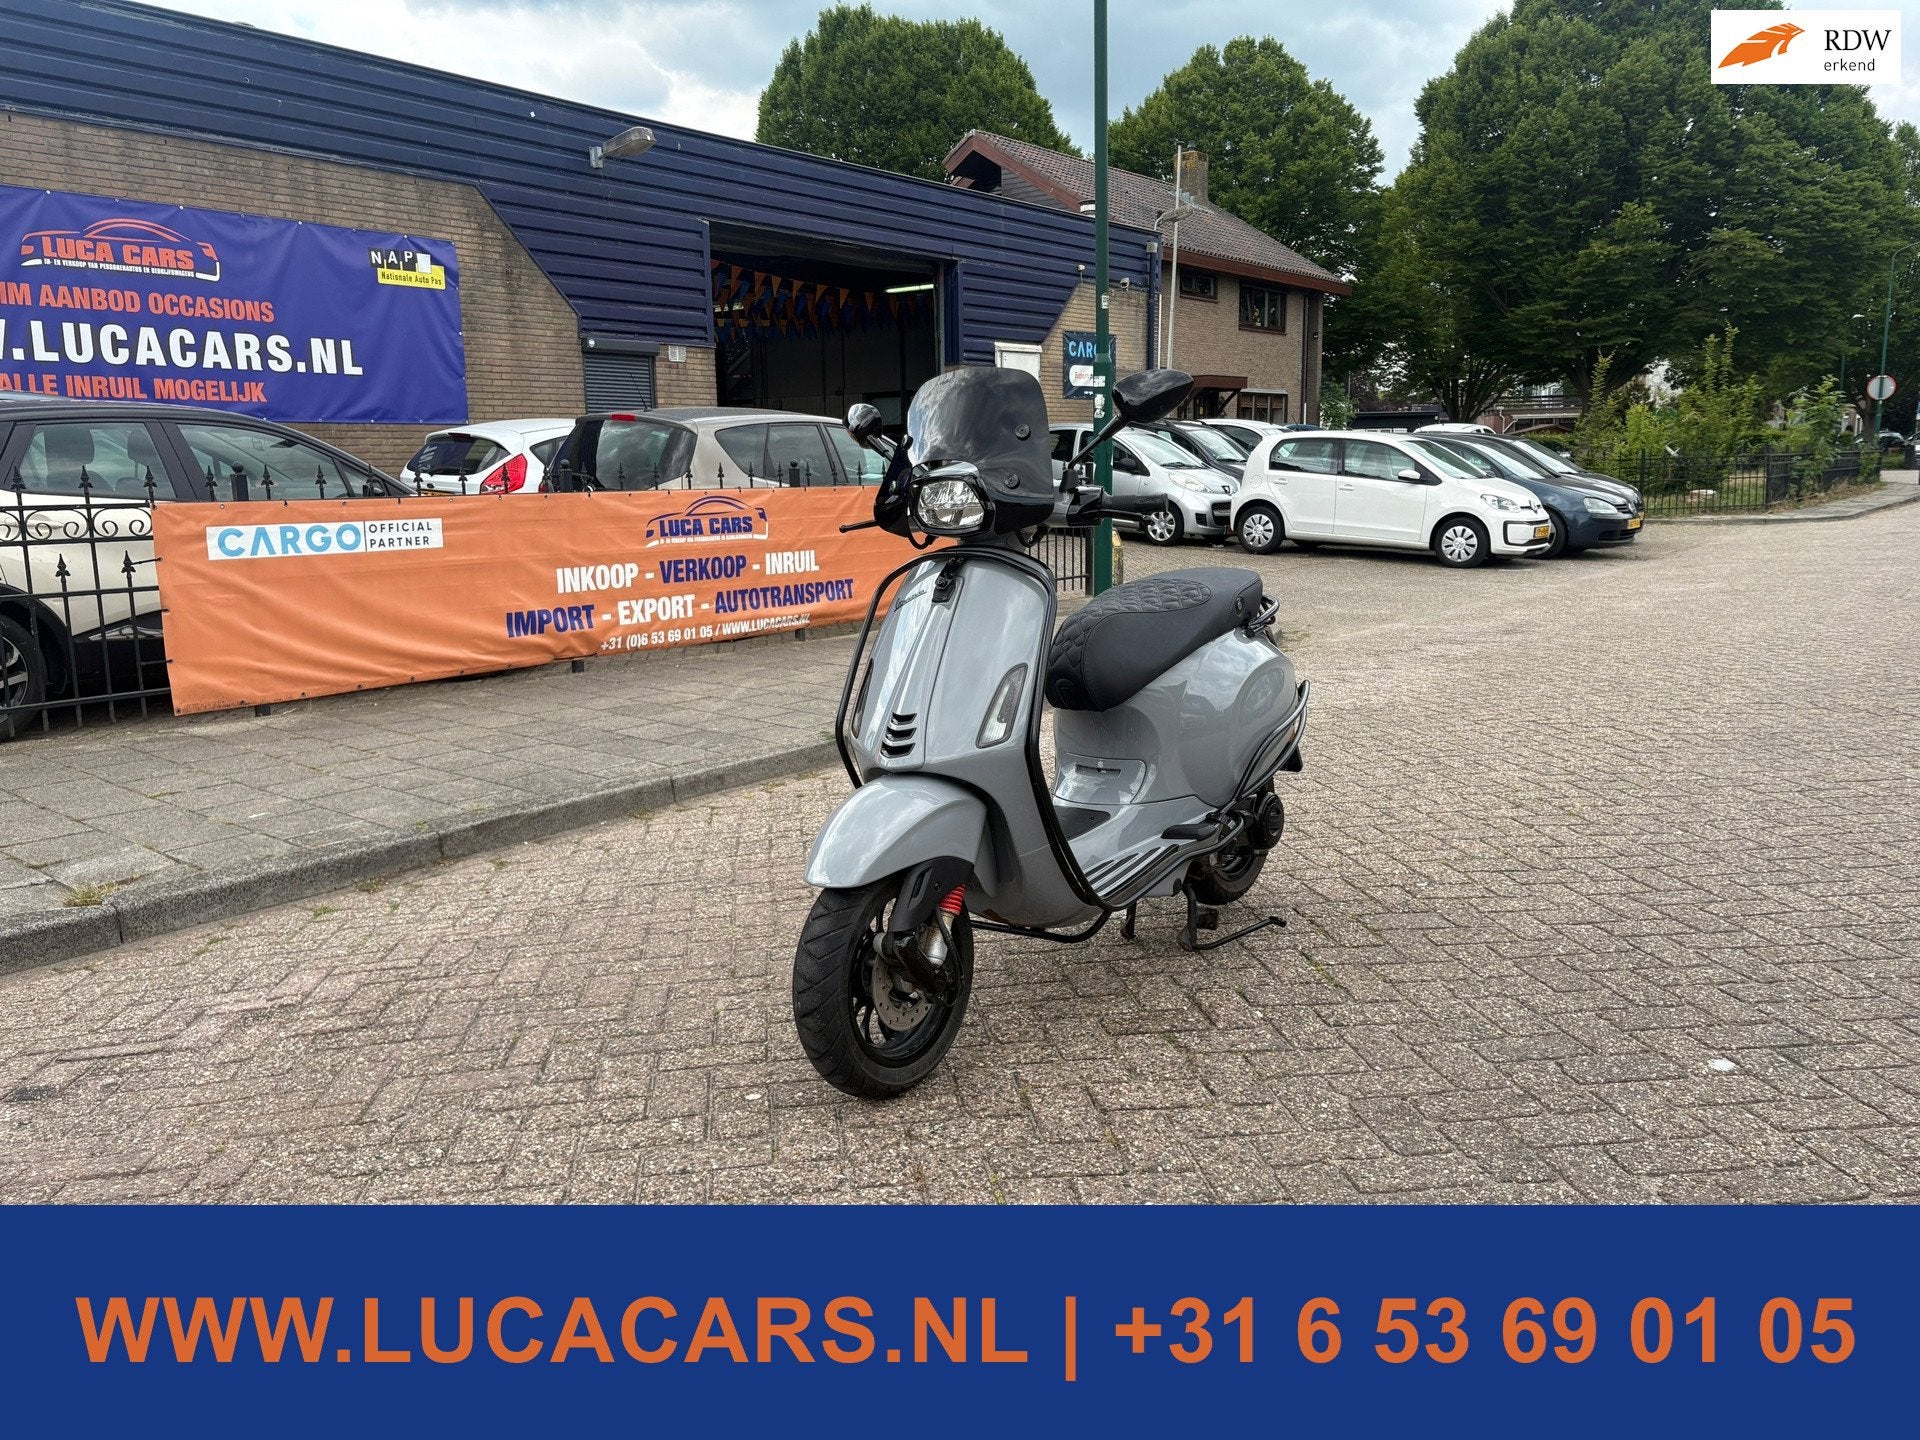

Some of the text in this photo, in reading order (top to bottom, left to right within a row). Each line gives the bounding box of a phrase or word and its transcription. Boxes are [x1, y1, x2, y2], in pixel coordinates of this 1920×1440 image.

[41, 236, 195, 270] LUCA CARS
[370, 250, 413, 264] NAP
[381, 271, 442, 286] Nationale Auto Pas
[39, 284, 141, 313] AANBOD
[148, 292, 275, 323] OCCASIONS
[0, 318, 364, 376] .LUCACARS.NL
[65, 374, 148, 400] INRUIL
[153, 378, 268, 403] MOGELIJK
[217, 523, 362, 557] CARGO
[368, 521, 433, 533] OFFICIAL
[370, 535, 430, 549] PARTNER
[659, 516, 753, 537] LUCA CARS
[556, 562, 639, 594] INKOOP
[659, 555, 747, 585] VERKOOP
[764, 549, 820, 576] INRUIL
[505, 604, 595, 638] IMPORT
[616, 593, 696, 626] EXPORT
[714, 578, 854, 614] AUTOTRANSPORT
[600, 635, 622, 650] +31
[626, 633, 648, 649] (0)6
[651, 630, 665, 645] 53
[667, 628, 682, 643] 69
[683, 626, 697, 641] 01
[700, 624, 713, 639] 05
[721, 613, 811, 636] WWW.LUCACARS.NL
